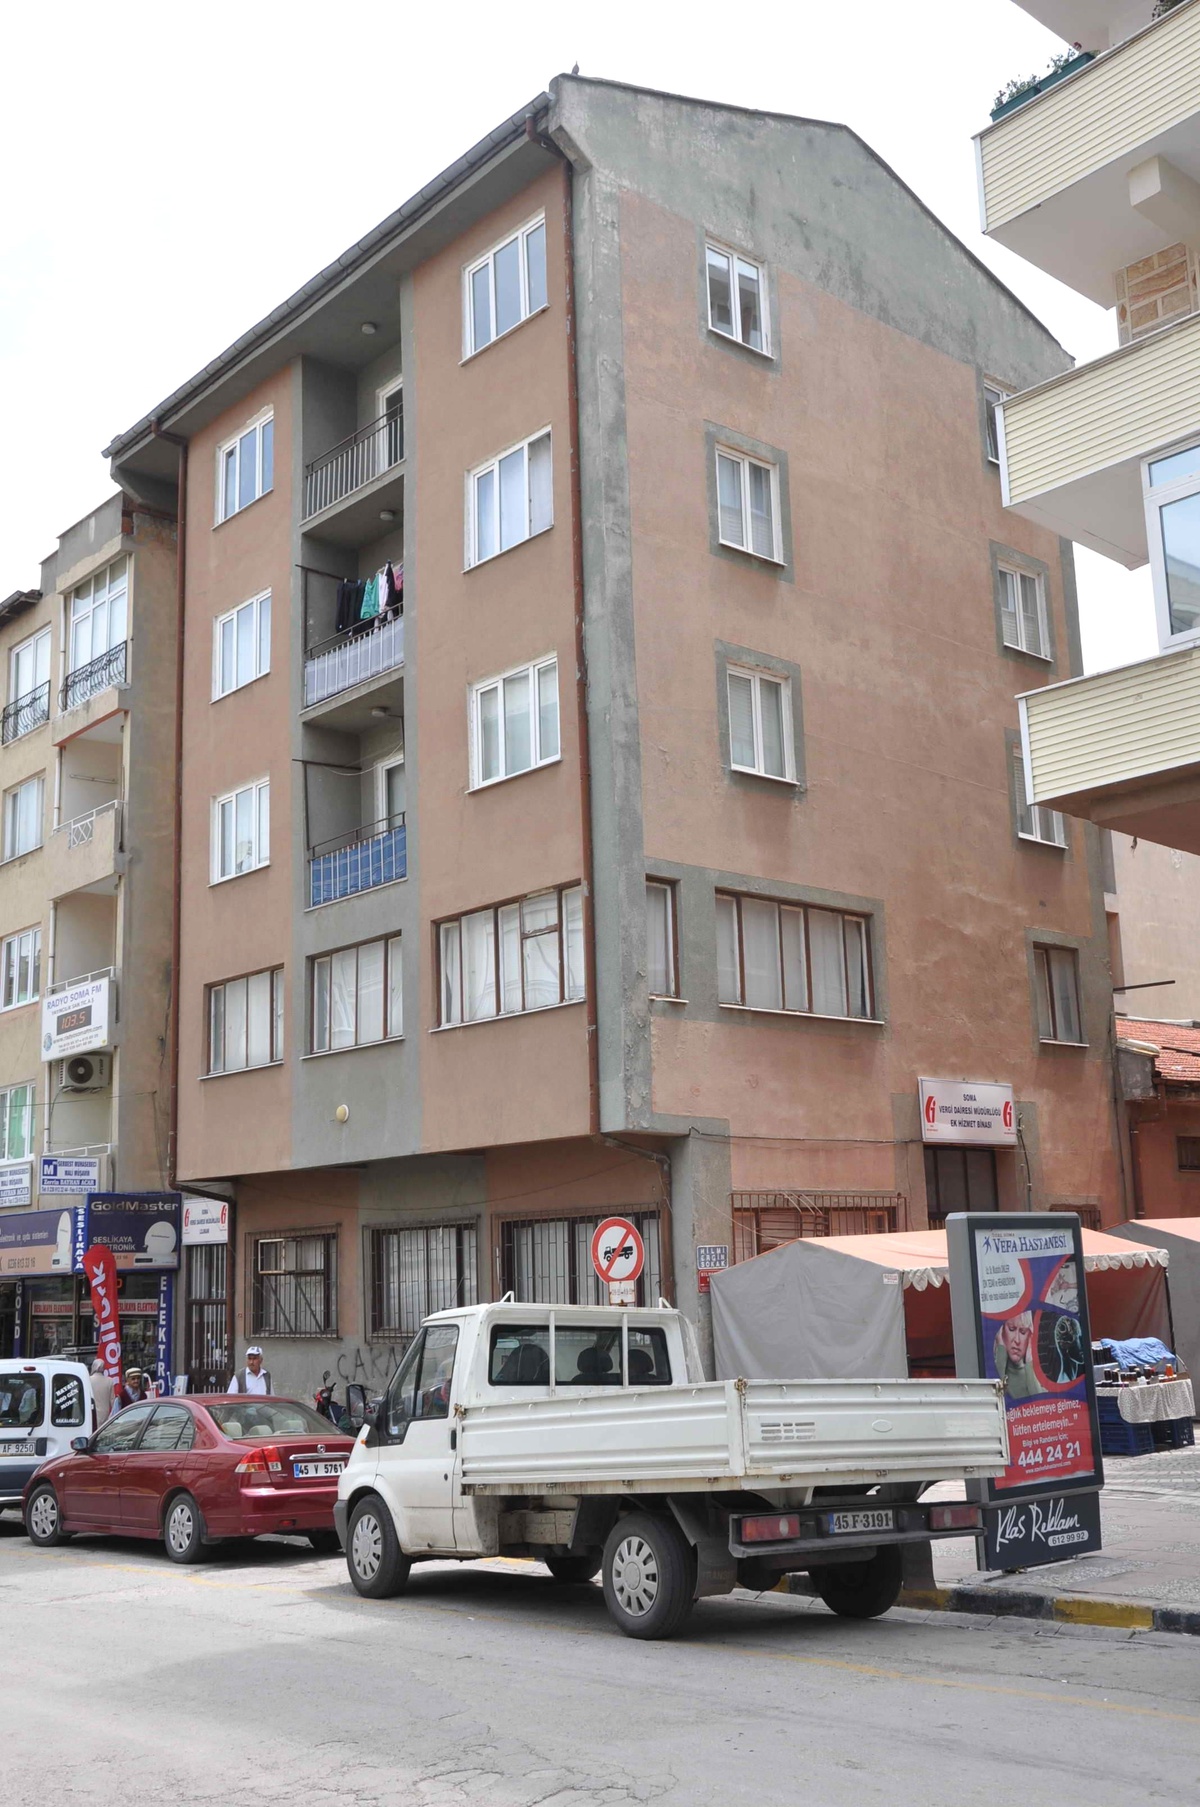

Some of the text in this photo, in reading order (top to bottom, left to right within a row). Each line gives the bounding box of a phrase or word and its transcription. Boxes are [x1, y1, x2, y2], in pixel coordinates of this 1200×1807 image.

[47, 984, 102, 1010] RADYO SOMA FM
[62, 1011, 86, 1029] 103.5
[939, 1105, 953, 1113] VERGİ
[954, 1106, 972, 1115] DAİRESİ
[958, 1118, 976, 1128] HİZMET
[977, 1119, 992, 1128] BİNASI
[91, 1201, 178, 1211] GoldMaster
[93, 1235, 132, 1243] SESLİKAYA
[992, 1233, 1067, 1253] VEFA HASTANESİ
[157, 1276, 167, 1394] ELEKTRO
[56, 1380, 78, 1396] HAYATA
[60, 1398, 77, 1410] MOLA
[1006, 1400, 1081, 1422] ağlık beklemeye gelmez,
[1013, 1423, 1031, 1436] lütfen
[15, 1443, 34, 1453] 9250
[1022, 1440, 1033, 1448] Bilgi
[1040, 1436, 1058, 1444] Randevu
[1018, 1440, 1080, 1467] 444 24 21
[299, 1464, 342, 1475] 45 V 5761
[835, 1514, 849, 1530] 45
[863, 1512, 890, 1528] 3191
[996, 1498, 1080, 1552] Klas Reklam
[1052, 1532, 1085, 1545] 612 99 92
